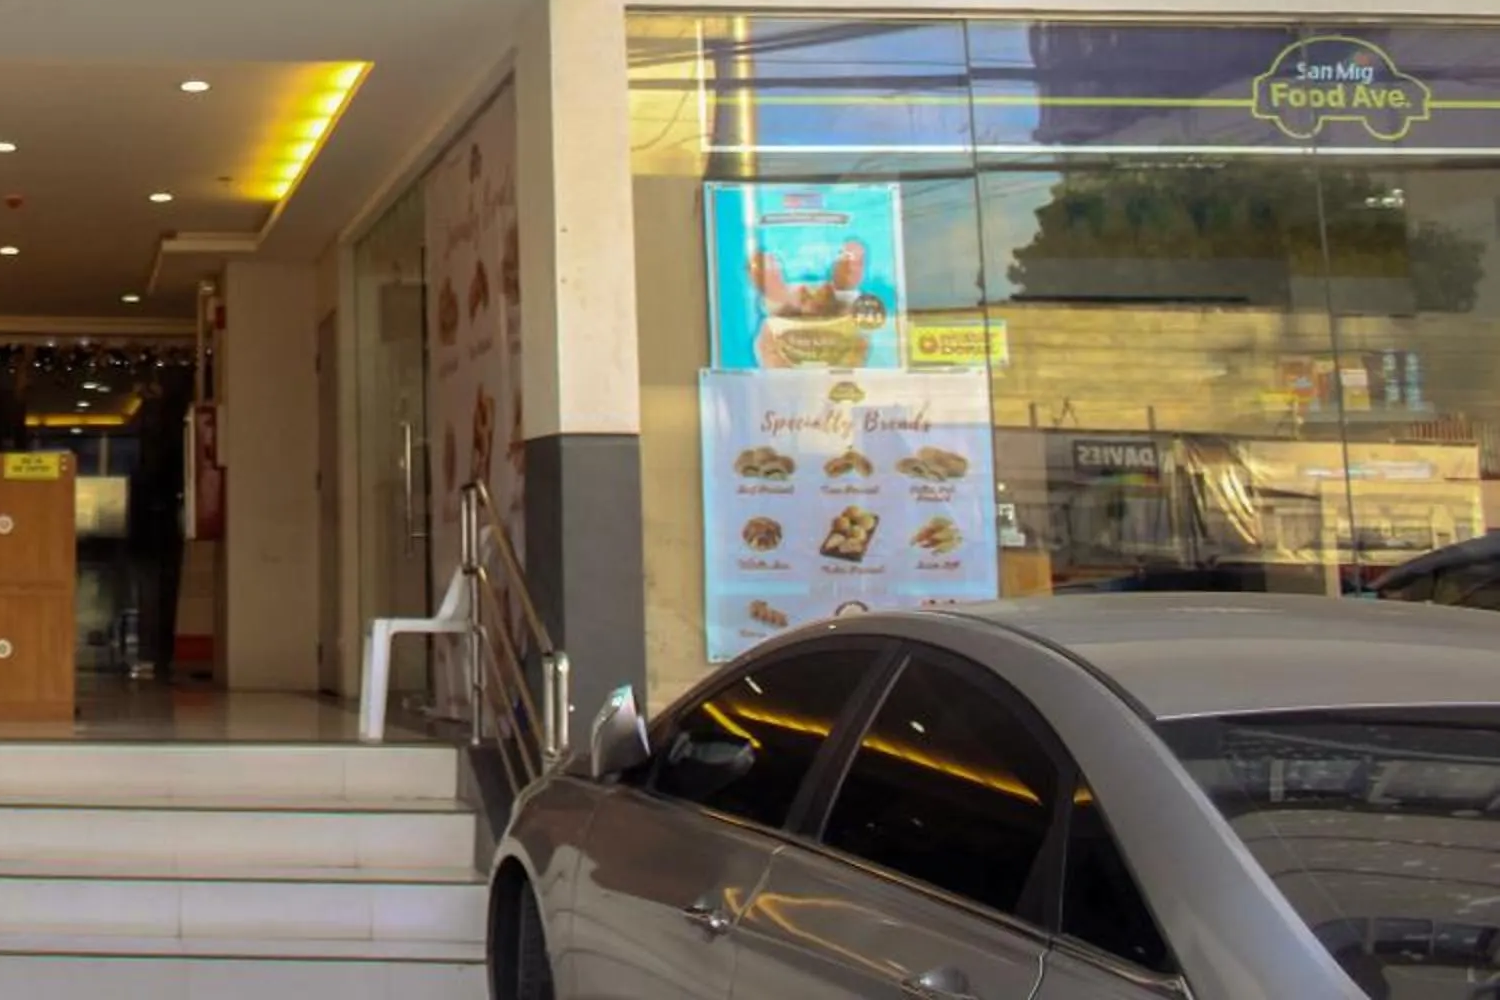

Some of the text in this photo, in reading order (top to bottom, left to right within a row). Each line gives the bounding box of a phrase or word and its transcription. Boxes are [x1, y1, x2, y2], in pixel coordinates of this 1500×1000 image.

[1295, 60, 1374, 85] San Mig
[1270, 83, 1412, 108] Food Ave.
[760, 410, 853, 439] Specialty
